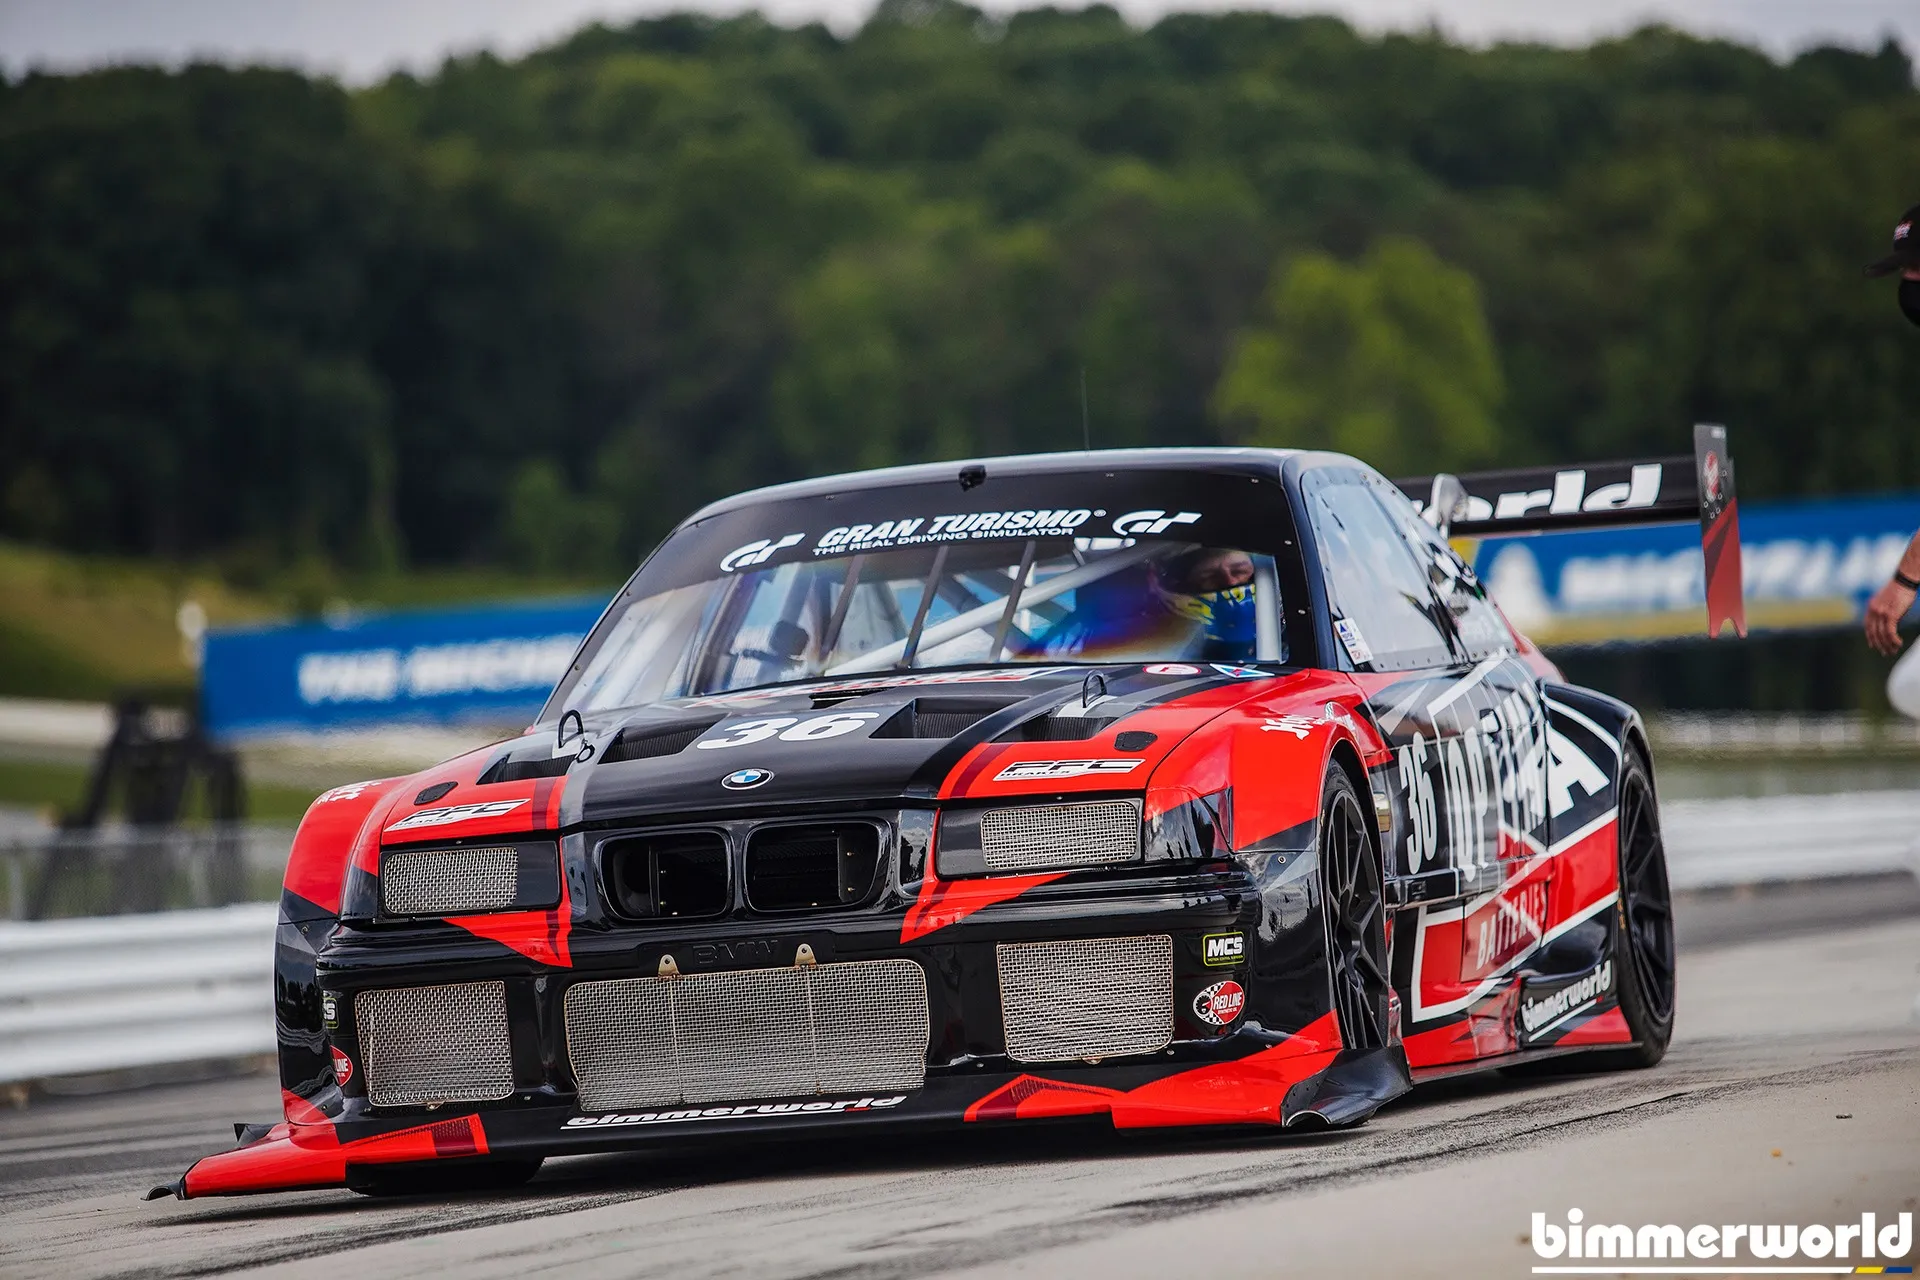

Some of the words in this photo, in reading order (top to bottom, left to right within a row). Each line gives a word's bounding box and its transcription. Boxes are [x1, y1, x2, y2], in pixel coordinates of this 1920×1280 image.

[812, 544, 846, 556] THE
[849, 539, 894, 551] REAL
[897, 531, 968, 545] DRIVING
[971, 527, 1074, 540] SIMULATOR
[817, 517, 925, 548] GRAN
[696, 712, 880, 749] 36
[1398, 730, 1437, 875] 36
[1476, 882, 1547, 971] BATTERIES
[1207, 936, 1243, 958] MCS
[1212, 995, 1229, 1011] RED
[1228, 991, 1243, 1008] LINE
[1521, 959, 1612, 1033] bimmerworld
[566, 1096, 907, 1127] bimmerworld
